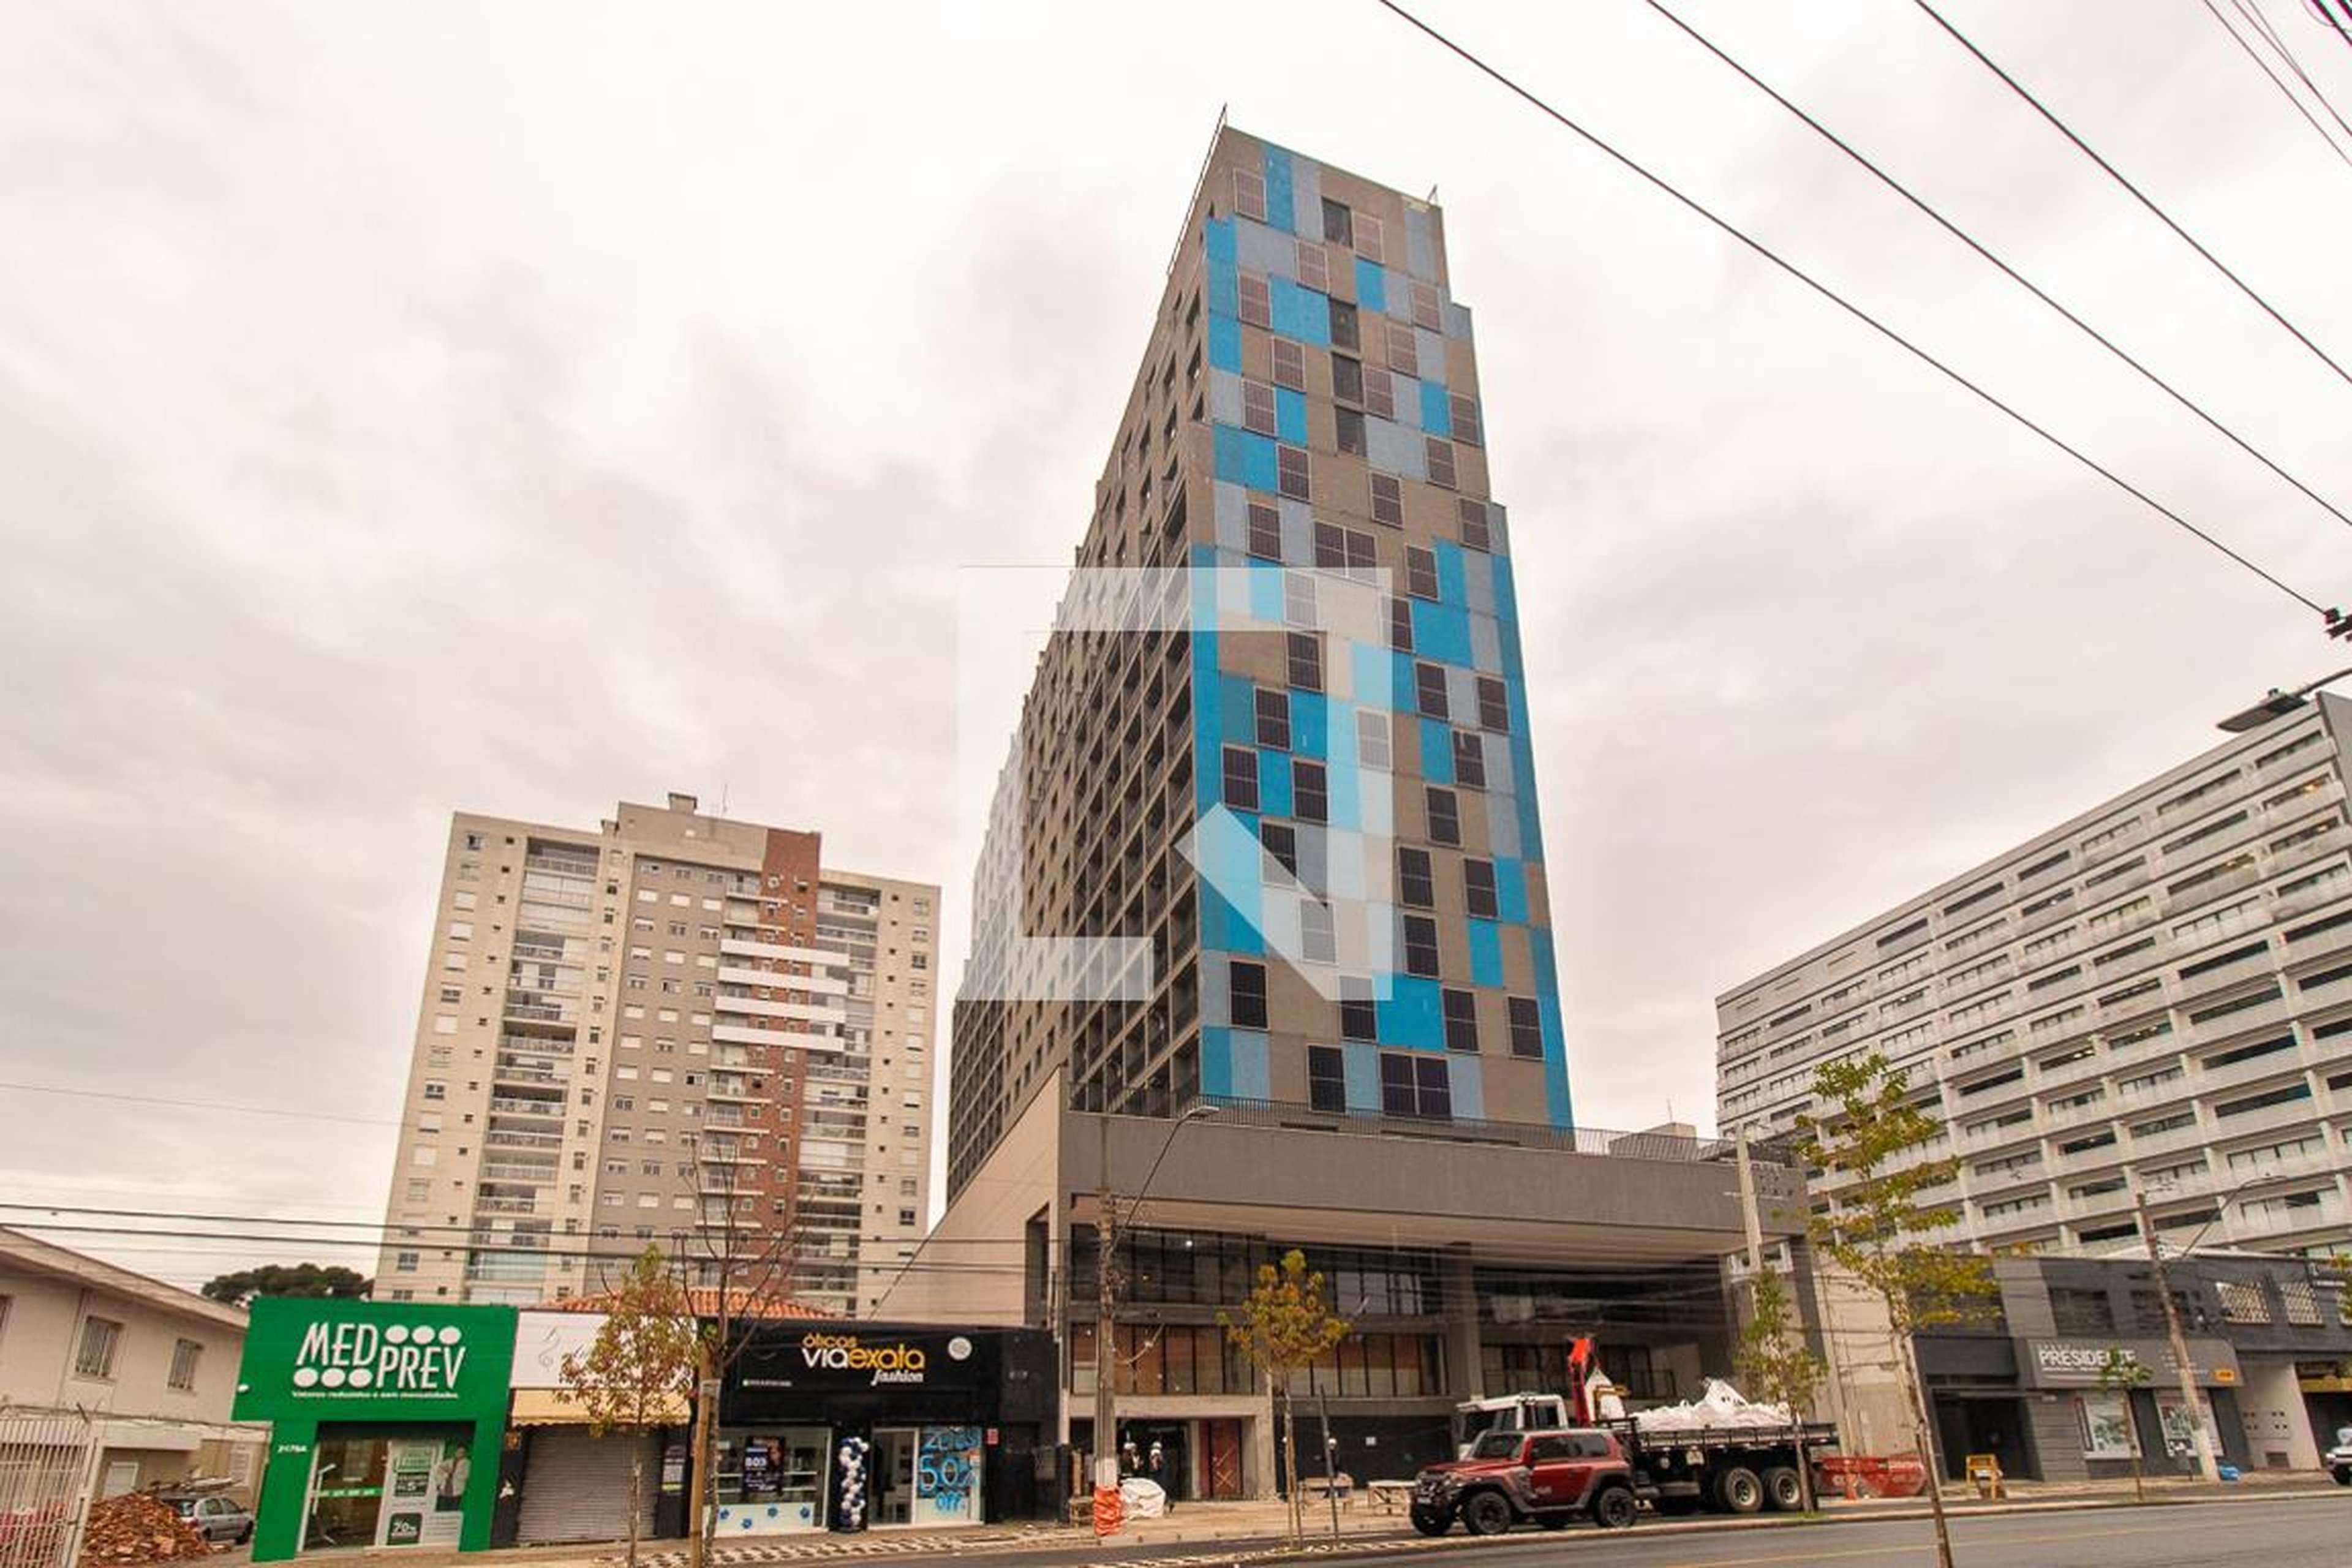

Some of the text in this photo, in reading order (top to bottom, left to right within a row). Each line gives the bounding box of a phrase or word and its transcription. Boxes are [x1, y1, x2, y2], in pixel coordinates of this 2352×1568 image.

[295, 1322, 378, 1366] MED
[2038, 1349, 2136, 1366] PRESIDETE
[375, 1346, 466, 1389] PREV
[870, 1368, 924, 1386] fashion
